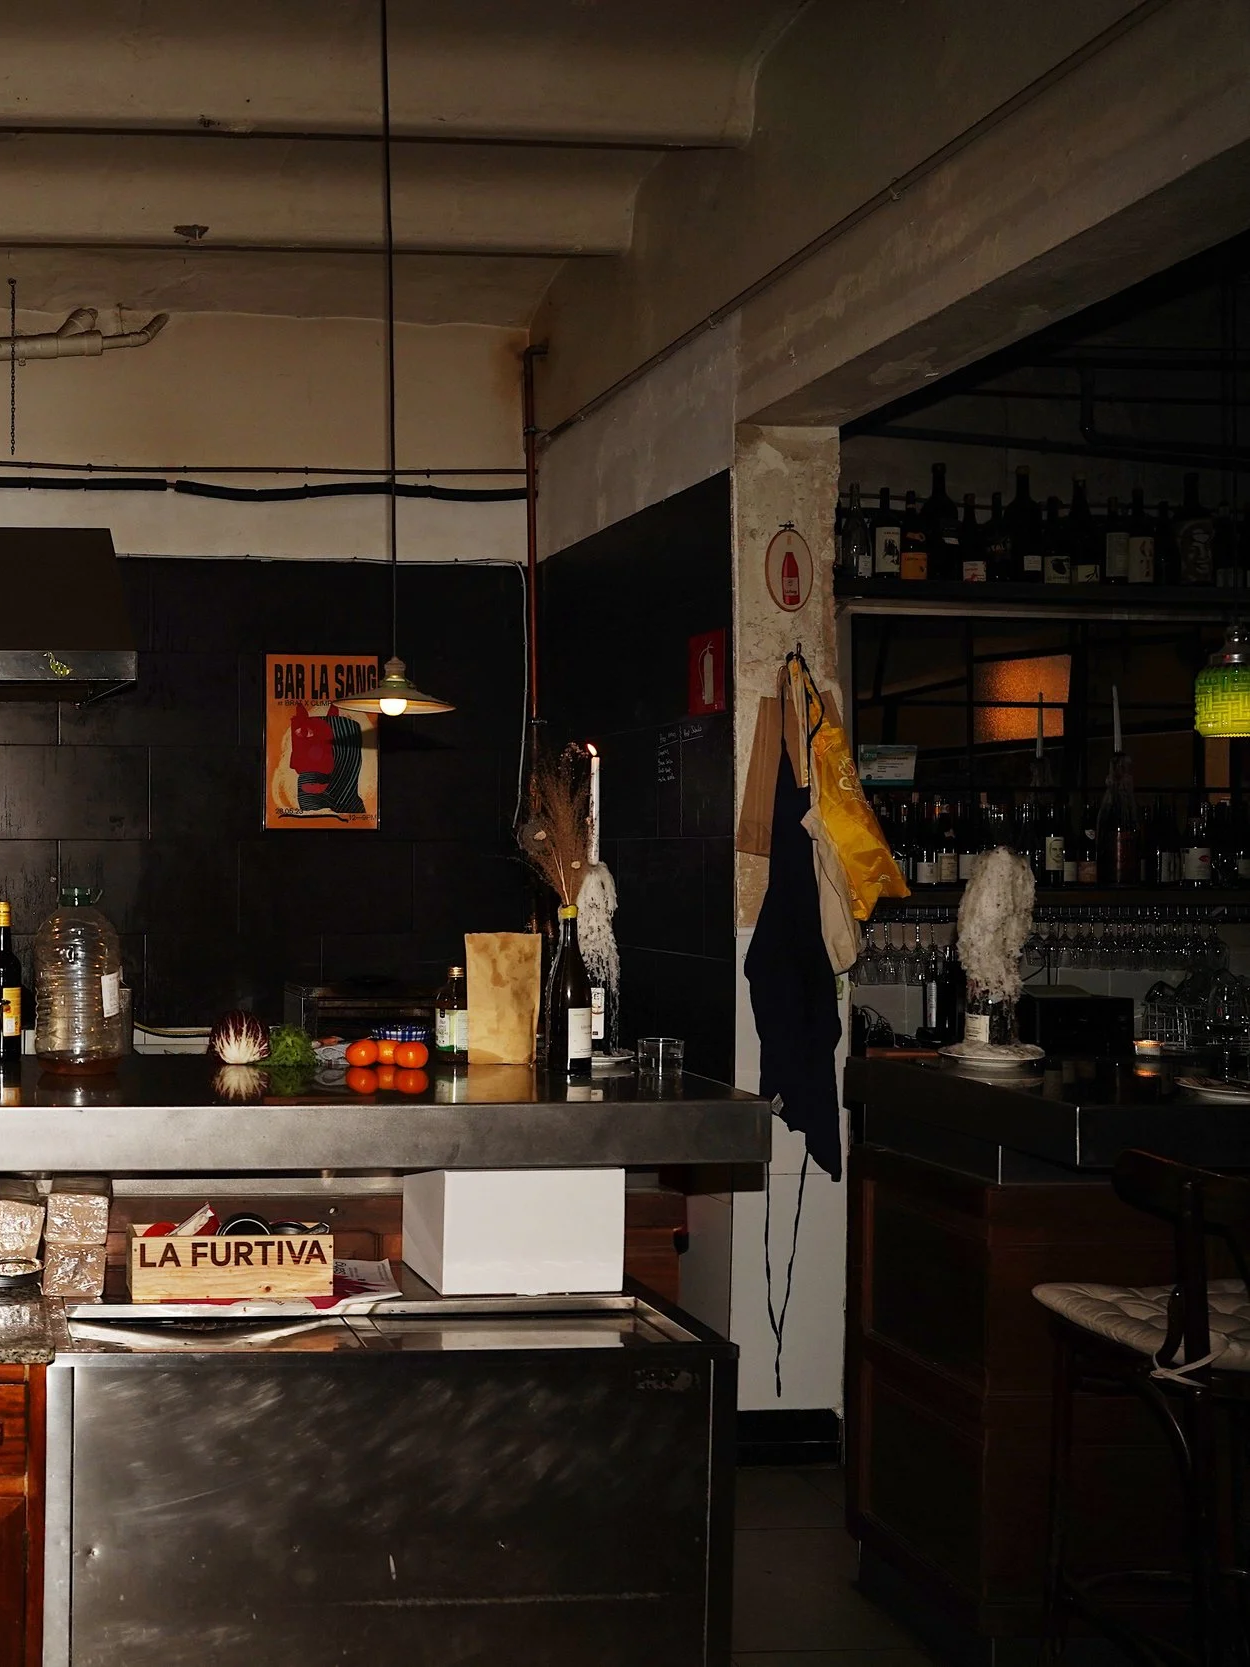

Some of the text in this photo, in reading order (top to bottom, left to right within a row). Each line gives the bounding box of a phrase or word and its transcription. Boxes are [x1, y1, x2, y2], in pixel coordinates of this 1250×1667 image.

[274, 664, 377, 699] BAR LA SANG
[139, 1240, 328, 1268] LA FURTIVA
